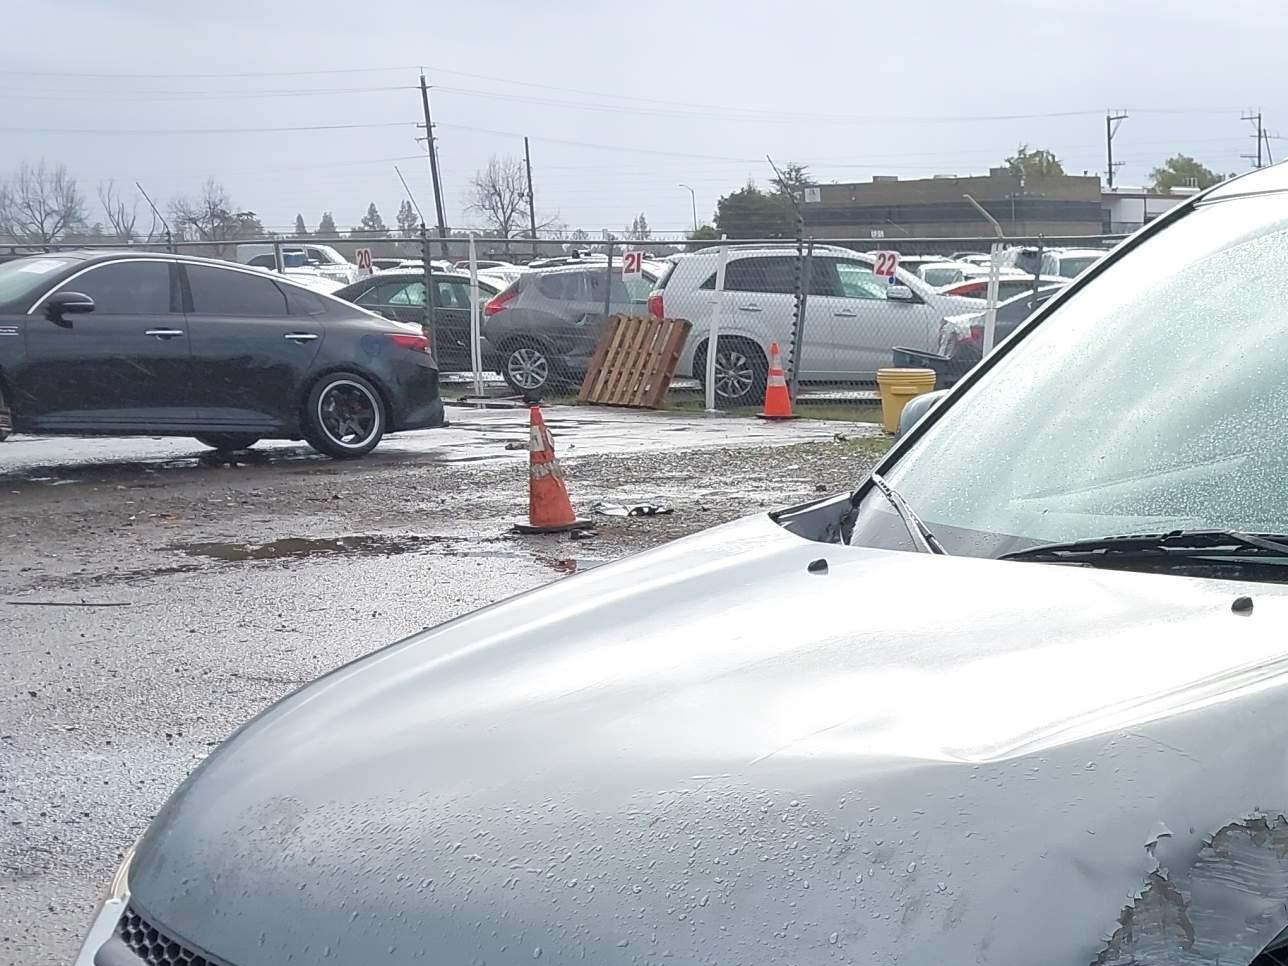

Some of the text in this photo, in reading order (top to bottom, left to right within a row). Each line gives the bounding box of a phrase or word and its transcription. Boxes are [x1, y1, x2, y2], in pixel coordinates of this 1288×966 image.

[357, 249, 370, 269] 20
[624, 252, 641, 273] 21
[876, 253, 896, 276] 22
